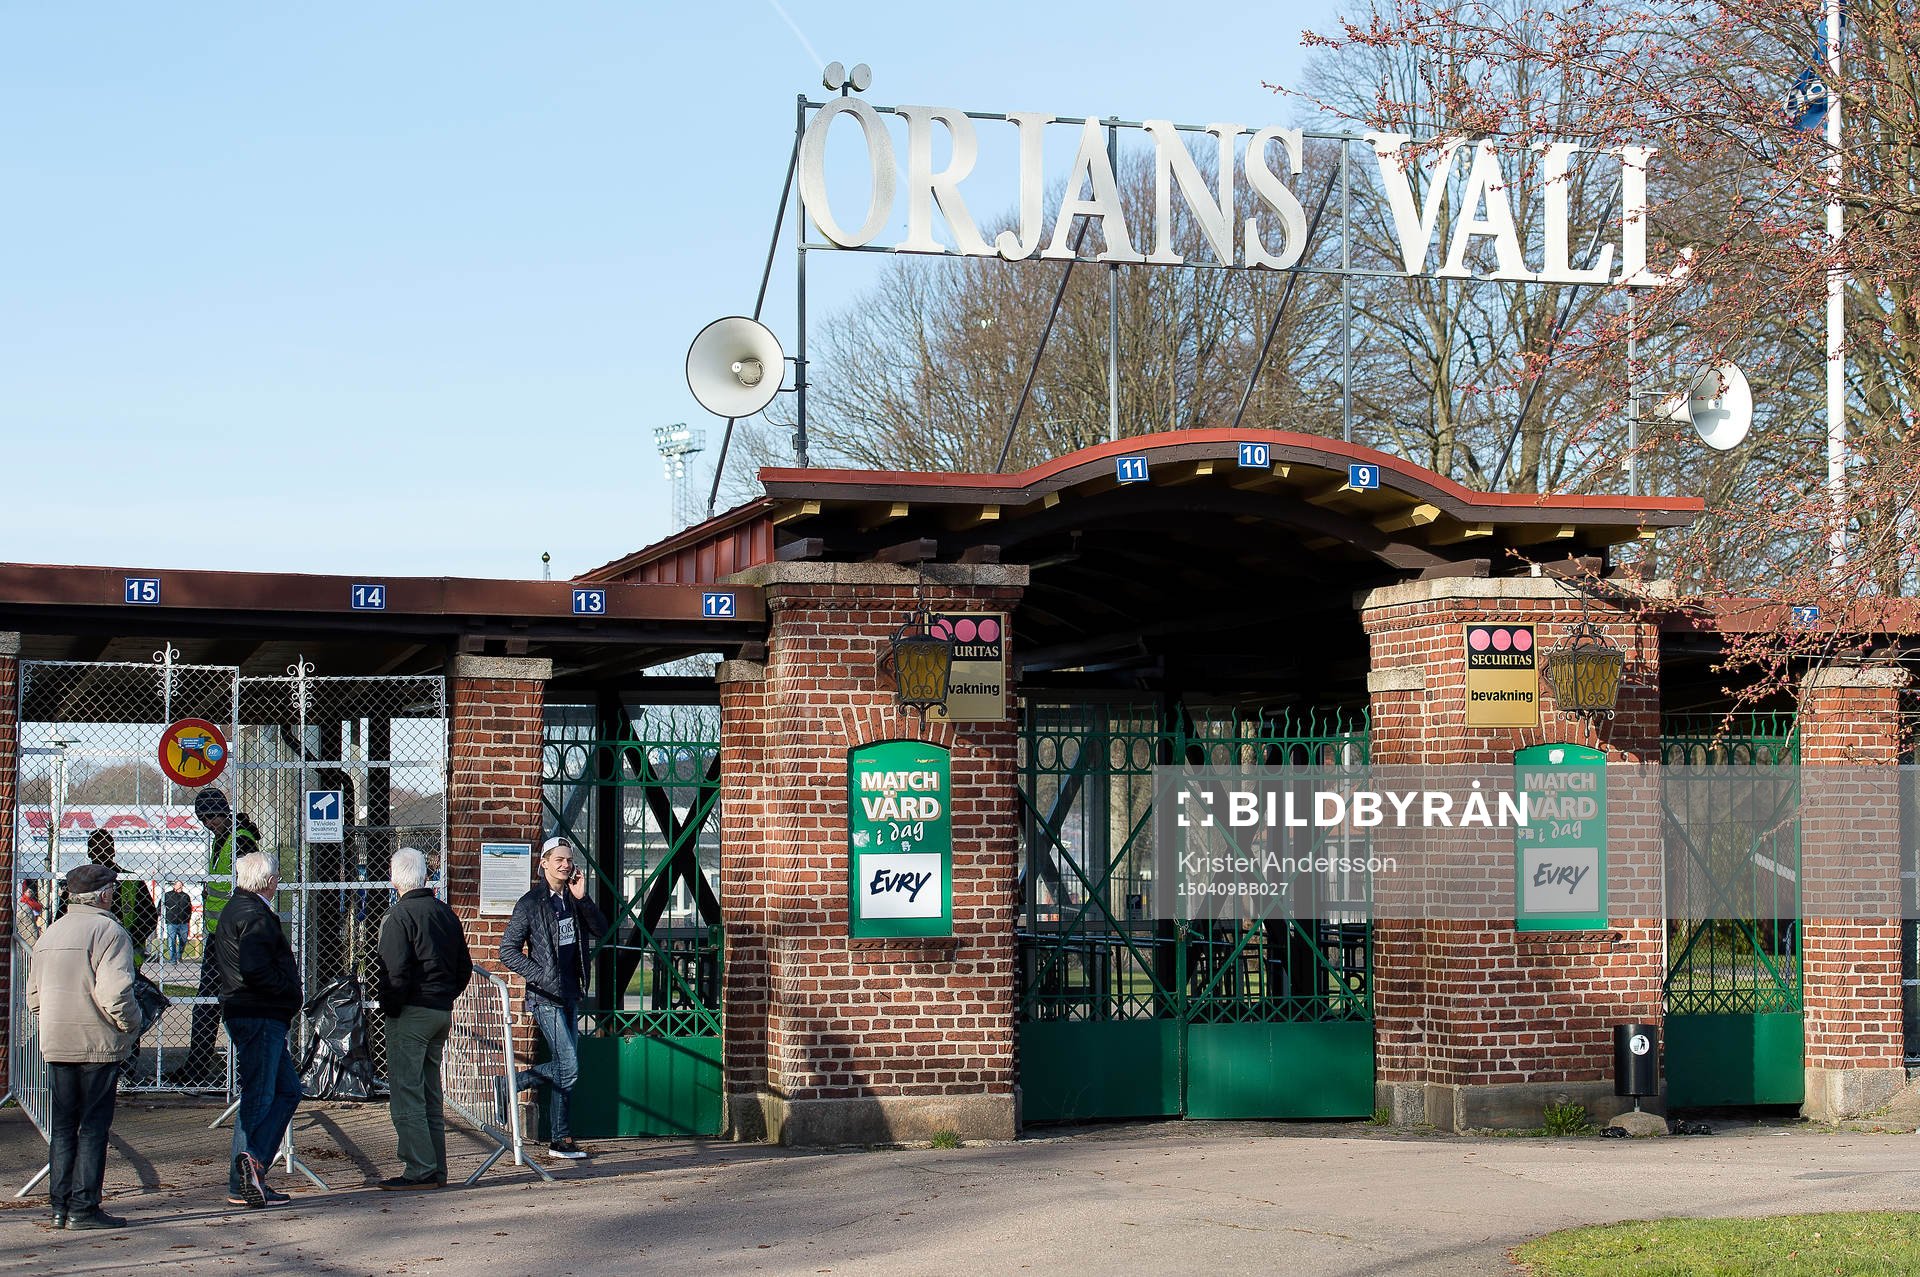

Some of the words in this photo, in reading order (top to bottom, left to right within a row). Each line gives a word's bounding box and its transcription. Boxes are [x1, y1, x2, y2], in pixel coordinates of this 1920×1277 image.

[800, 62, 1307, 270] ÖRJANS
[1363, 132, 1695, 287] VALL
[1242, 446, 1266, 465] 10
[1121, 460, 1145, 478] 11
[1358, 467, 1371, 486] 9
[129, 580, 156, 601] 15
[355, 587, 382, 607] 14
[576, 592, 602, 612] 13
[706, 596, 731, 615] 12
[1802, 609, 1811, 622] 7
[953, 645, 999, 657] URITAS
[1471, 654, 1532, 665] SECURITAS
[948, 682, 1000, 696] vakning
[1471, 689, 1534, 703] bevakning
[860, 771, 940, 791] MATCH
[1524, 772, 1597, 792] MATCH
[861, 790, 941, 821] VÄRD
[1527, 790, 1599, 821] VÄRD
[876, 829, 884, 846] i
[888, 821, 924, 842] dag
[1538, 828, 1546, 843] i
[1550, 820, 1582, 840] dag
[559, 922, 573, 934] OR
